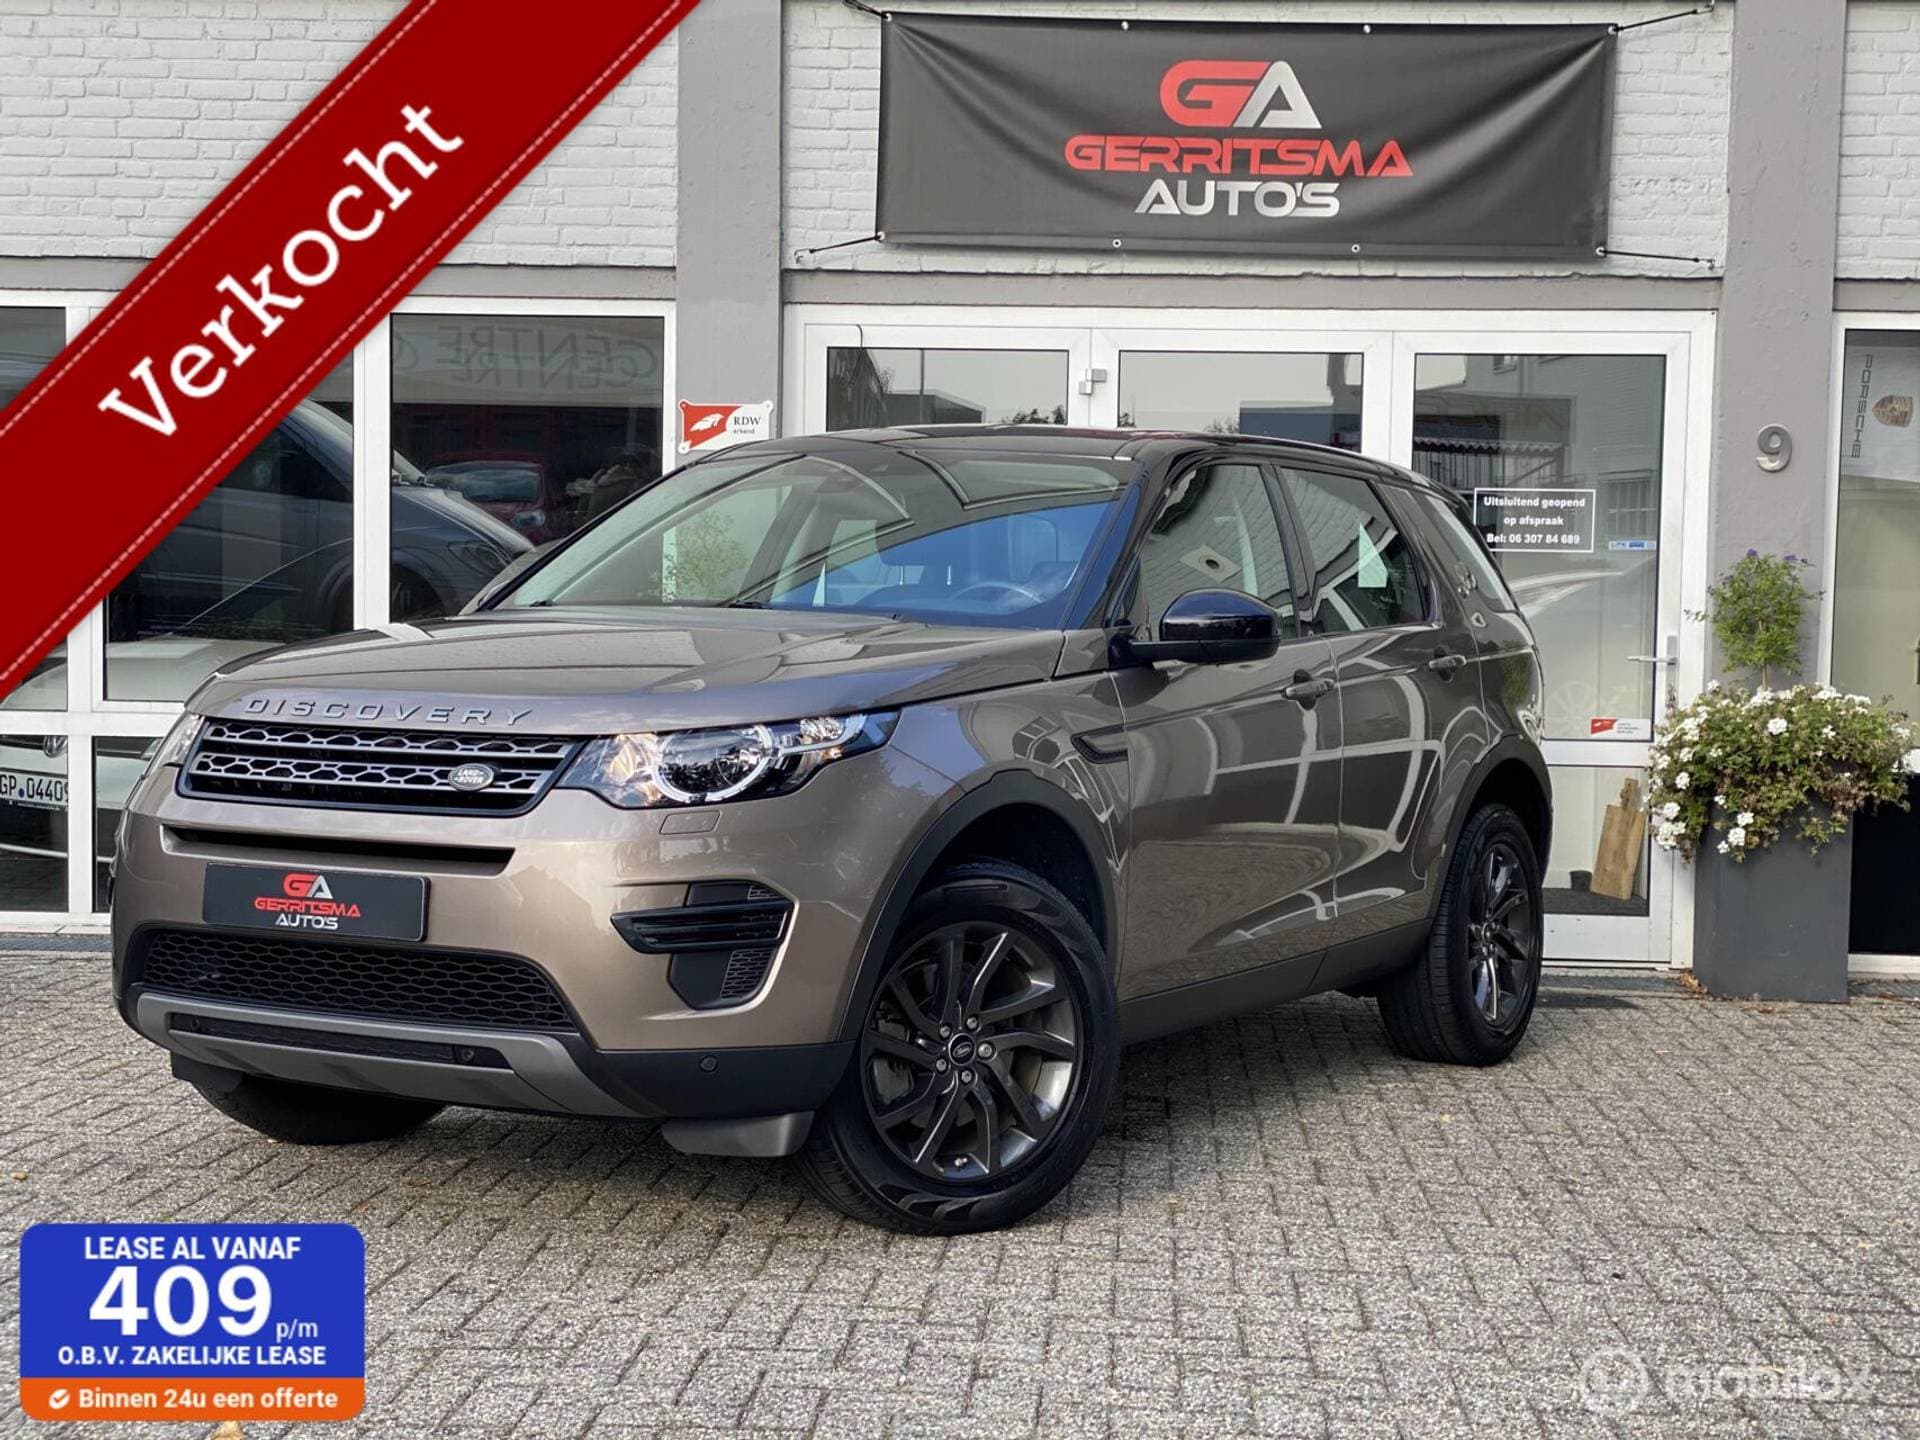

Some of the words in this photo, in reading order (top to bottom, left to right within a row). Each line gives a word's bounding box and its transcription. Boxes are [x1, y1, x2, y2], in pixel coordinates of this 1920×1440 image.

[1160, 60, 1321, 129] GA
[1064, 134, 1414, 177] GERRITSMA
[1135, 179, 1340, 218] AUTO'S
[1851, 354, 1873, 458] PORSCHE
[733, 415, 761, 426] RDW
[1756, 424, 1793, 472] 9
[1484, 496, 1539, 507] Uitsluitend
[1541, 497, 1586, 509] geopend
[1503, 517, 1517, 527] op
[1518, 514, 1564, 527] afspraak
[1486, 533, 1507, 544] Bel:
[1508, 534, 1522, 544] 06
[1524, 534, 1543, 545] 307
[1545, 534, 1558, 545] 84
[1561, 534, 1581, 545] 689
[244, 699, 533, 726] DISCOVERY
[283, 873, 334, 899] GA
[254, 896, 362, 917] GERRITSMA
[275, 912, 338, 930] AUTO'S
